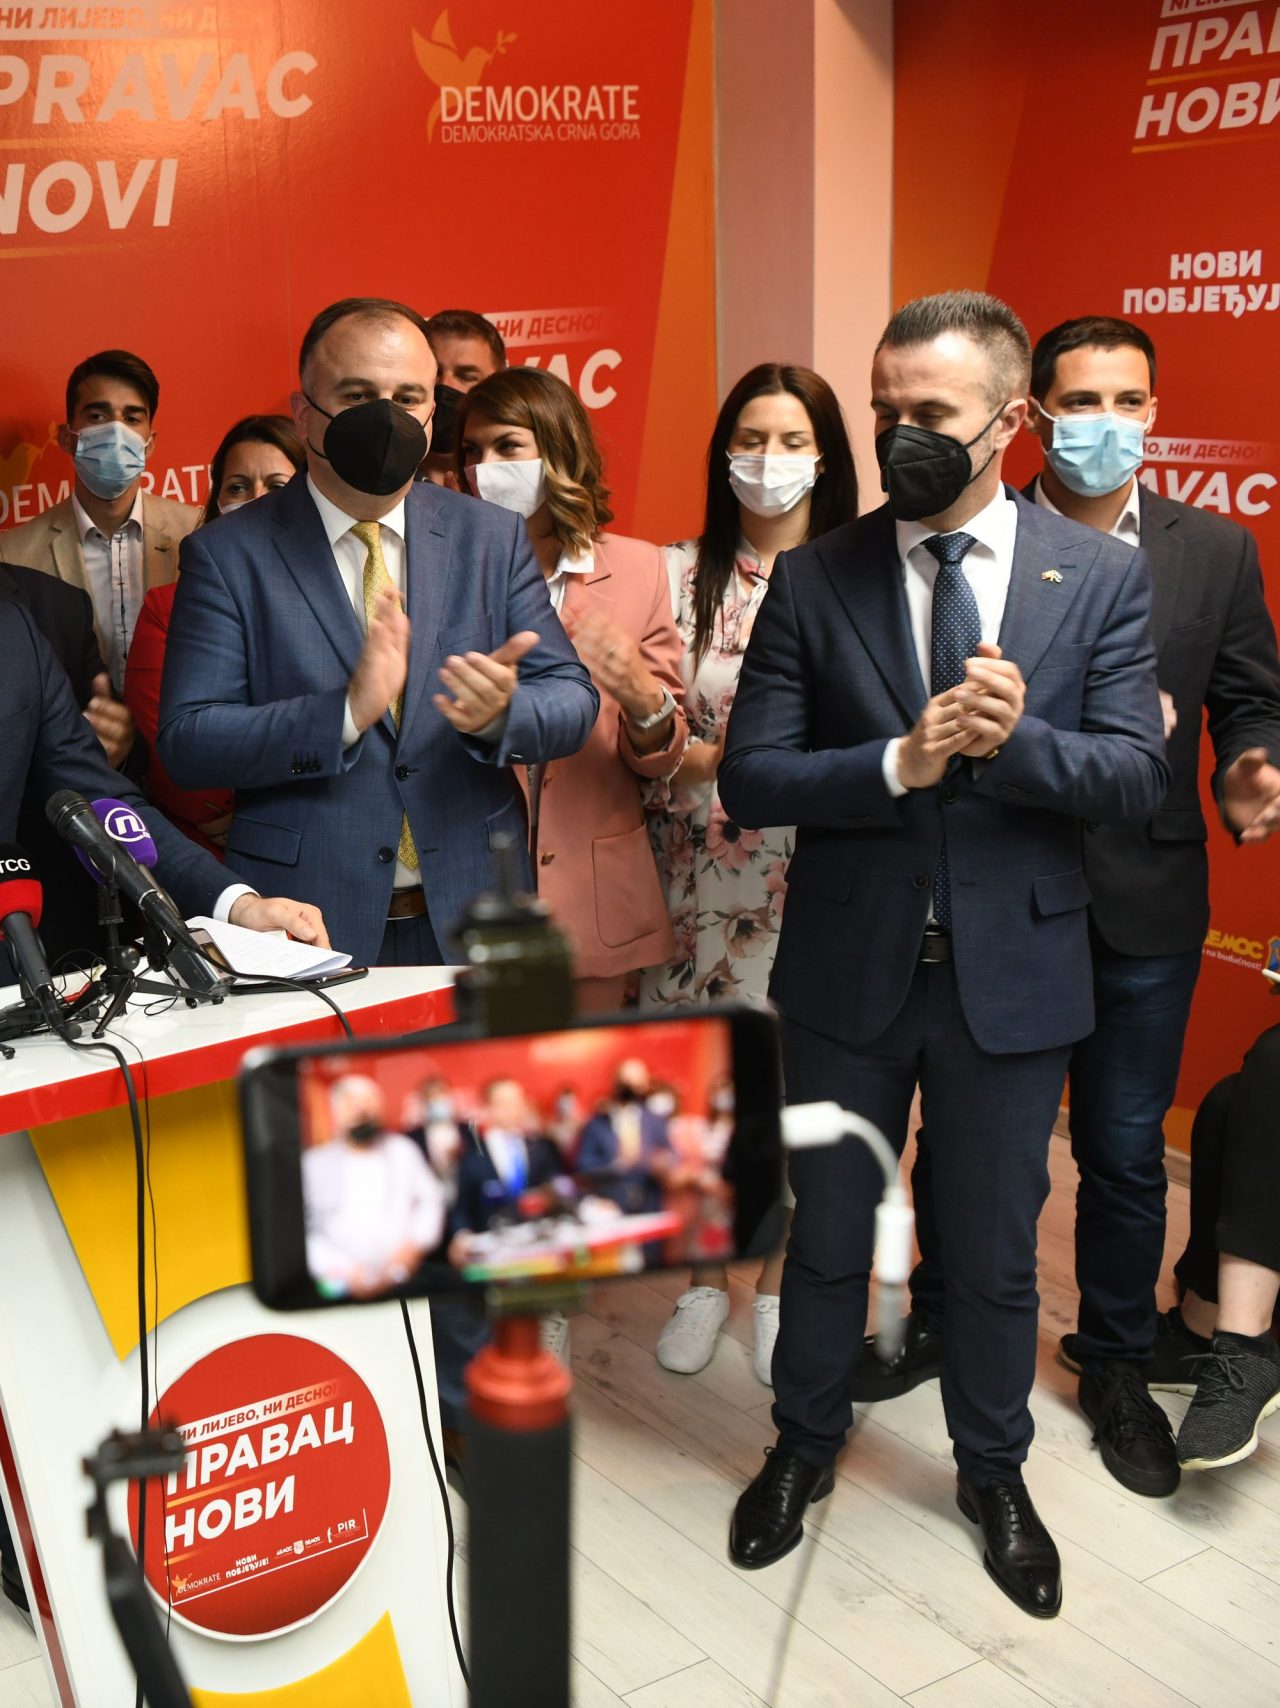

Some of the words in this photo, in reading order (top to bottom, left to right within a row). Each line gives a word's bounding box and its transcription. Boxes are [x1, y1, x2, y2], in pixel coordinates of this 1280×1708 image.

[440, 85, 640, 122] DEMOKRATE
[441, 124, 554, 143] DEMOKRATSKA
[557, 123, 597, 141] CRNA
[600, 123, 640, 141] GORA
[1170, 249, 1263, 280] НОВИ
[527, 313, 602, 339] ДЕСНО!
[1168, 443, 1191, 456] НИ
[1193, 444, 1261, 459] ДЕСНО!
[200, 1408, 260, 1436] ЛИЈЕВО,
[263, 1400, 283, 1417] НИ
[285, 1383, 337, 1411] ДЕСНО!
[164, 1475, 295, 1554] НОВИ
[337, 1519, 357, 1533] PIR
[225, 1557, 270, 1579] ПОБЈЕЂУЈЕ!
[235, 1554, 258, 1567] НОВИ
[178, 1572, 222, 1594] DEMOKRATE
